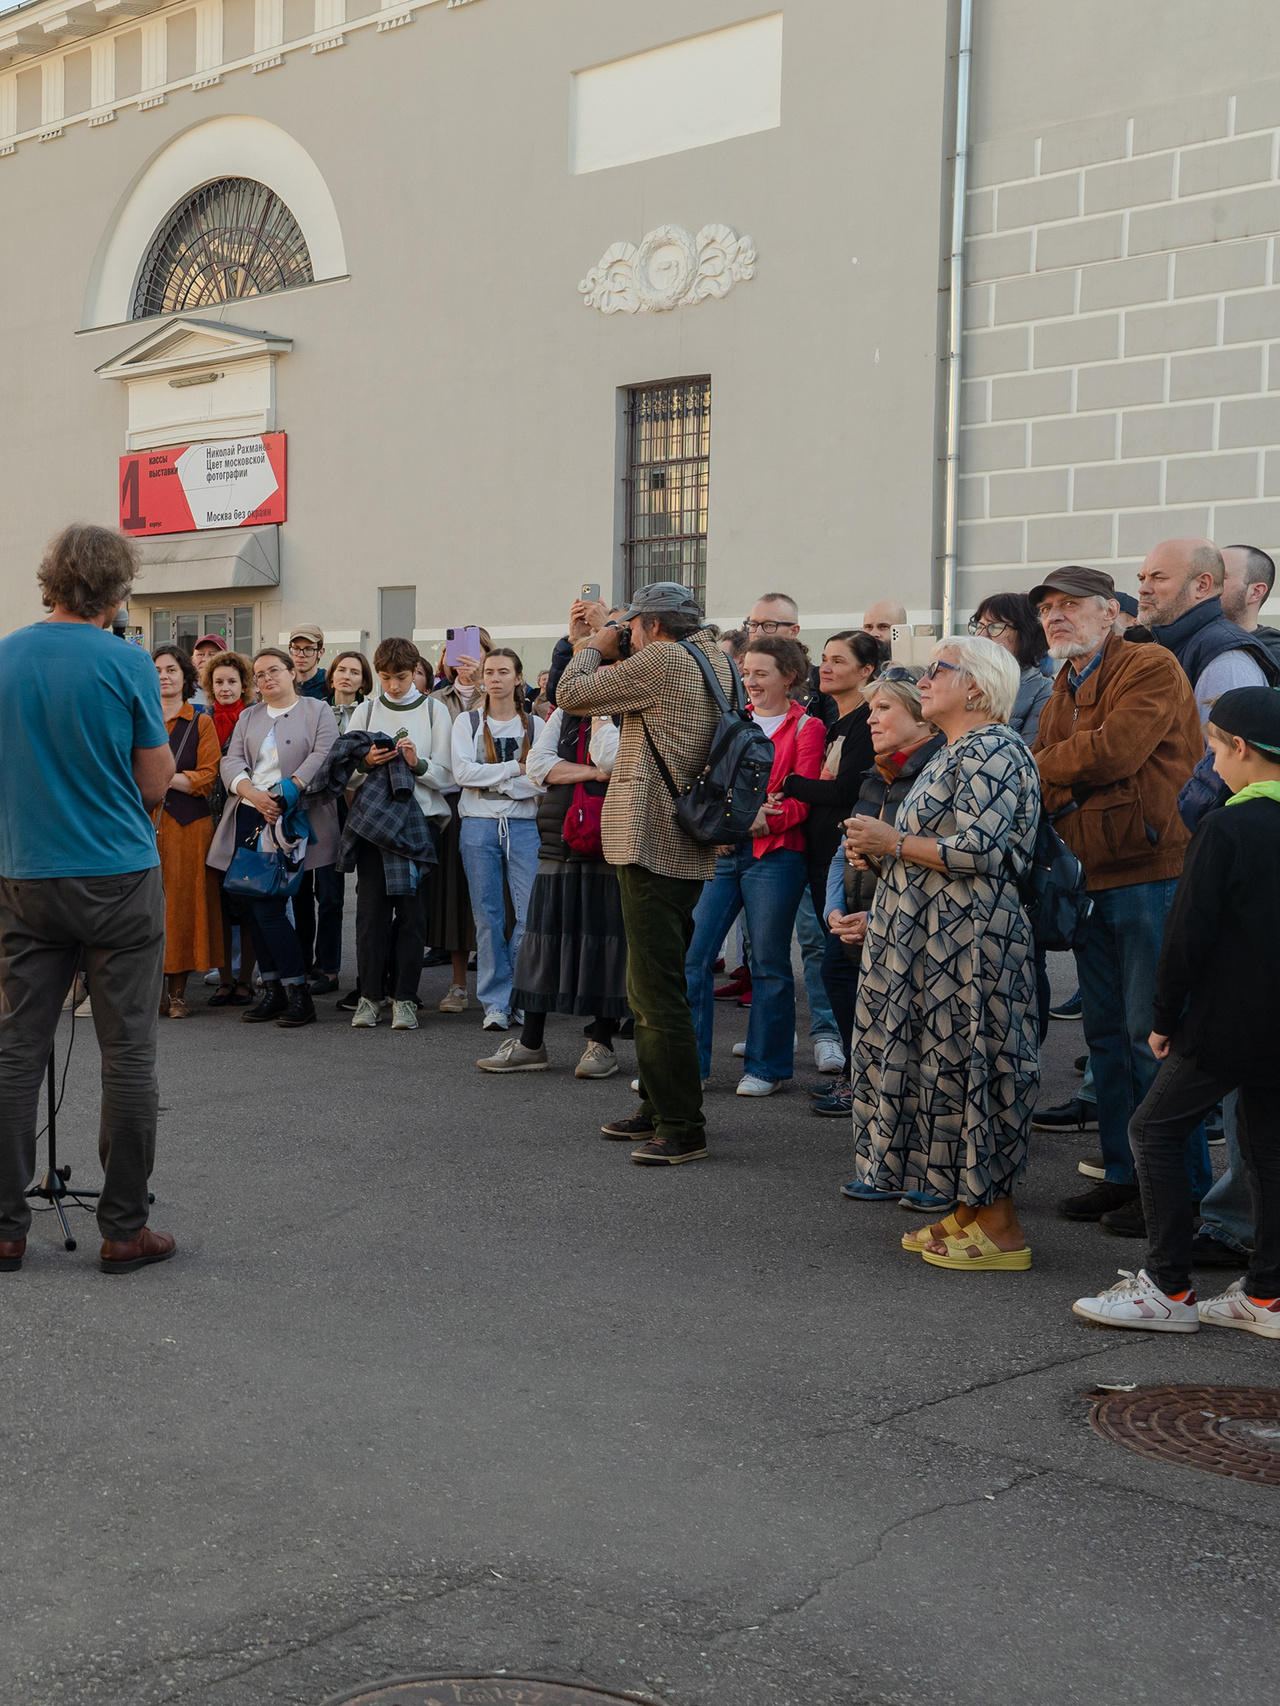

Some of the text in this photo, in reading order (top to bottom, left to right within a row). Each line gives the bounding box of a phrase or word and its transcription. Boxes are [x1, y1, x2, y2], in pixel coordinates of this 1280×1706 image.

[206, 445, 235, 458] Николай
[149, 455, 168, 465] кассы
[206, 453, 266, 471] Цвет московской
[149, 467, 178, 478] выставки
[206, 469, 248, 484] фотографии
[122, 460, 146, 530] 1
[206, 508, 272, 522] Москва без окраин
